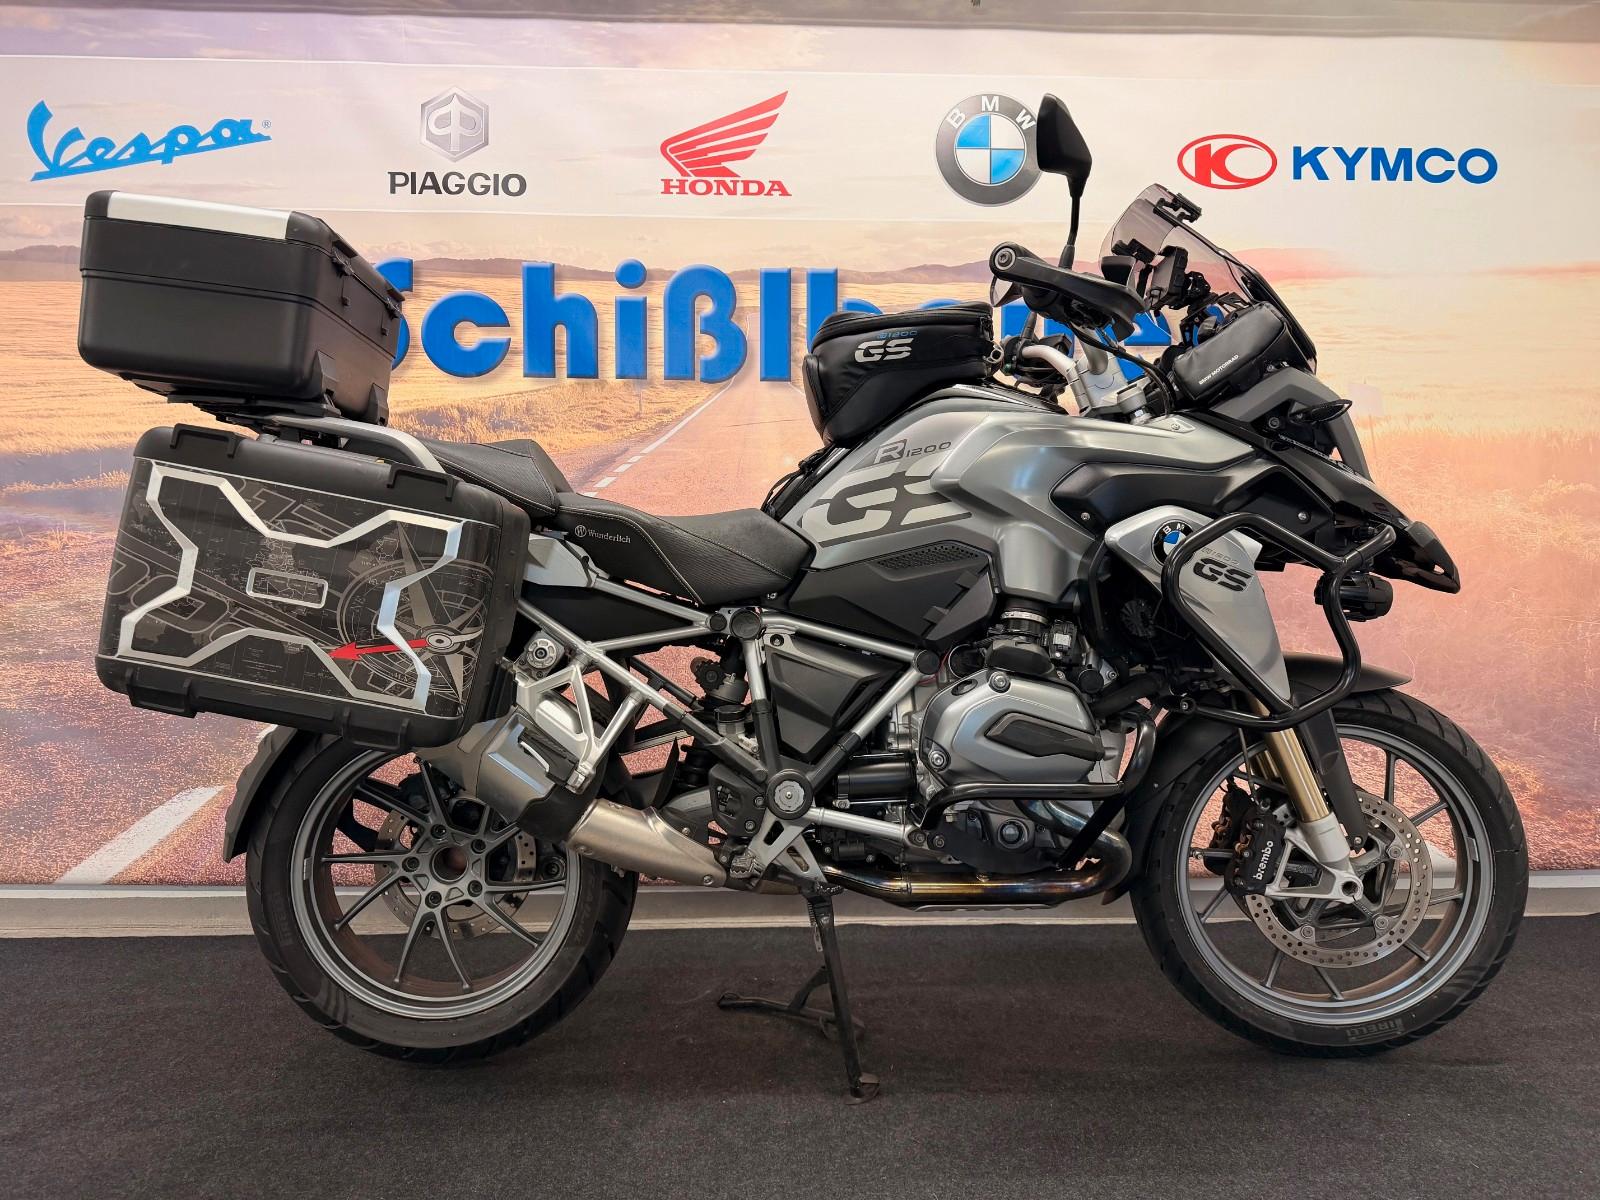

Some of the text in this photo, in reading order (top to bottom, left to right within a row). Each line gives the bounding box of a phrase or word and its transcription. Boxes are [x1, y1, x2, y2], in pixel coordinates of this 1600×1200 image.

[946, 95, 1036, 130] BMW
[1292, 146, 1498, 184] KYMCO
[387, 171, 527, 197] PIAGGIO
[660, 178, 792, 197] HONDA
[854, 337, 914, 363] GS
[588, 529, 631, 544] Wunderlich
[1193, 557, 1252, 592] GS
[1252, 840, 1274, 880] brembo
